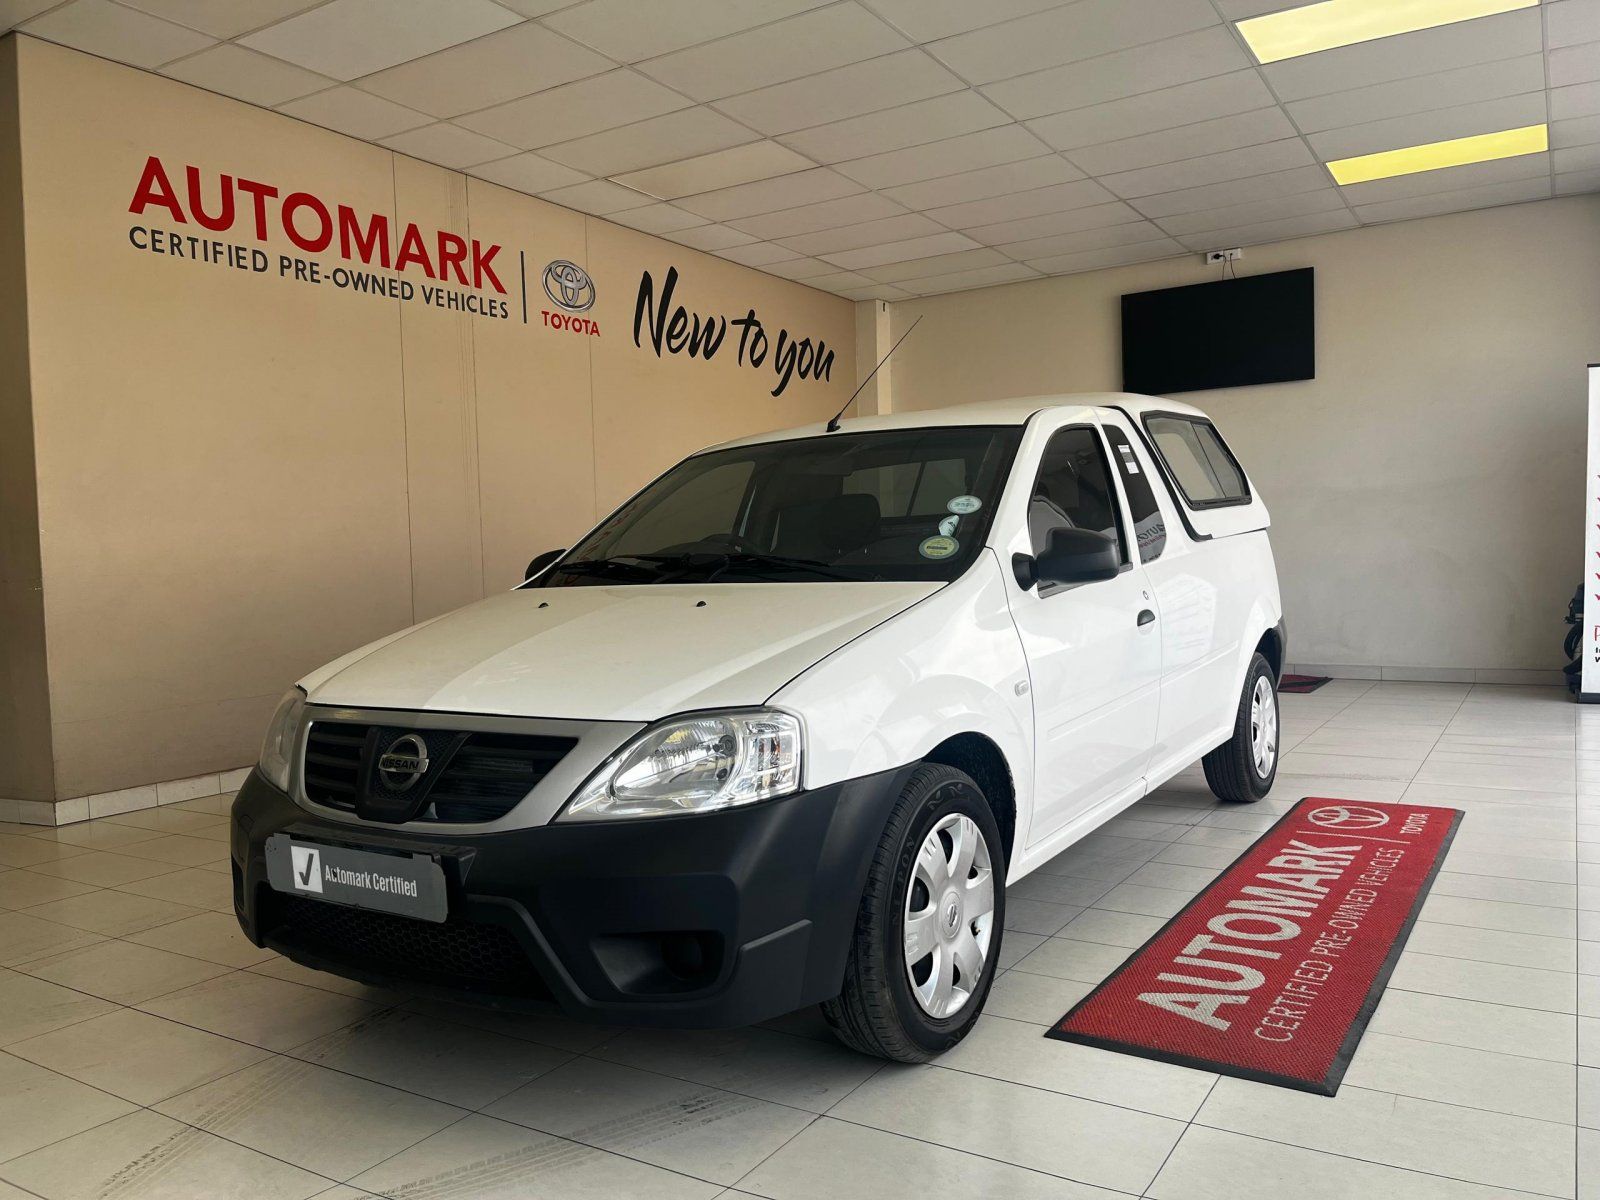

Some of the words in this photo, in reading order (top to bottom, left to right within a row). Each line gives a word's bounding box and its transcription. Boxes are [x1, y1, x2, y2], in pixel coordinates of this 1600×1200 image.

[128, 156, 507, 295] AUTOMARK
[129, 226, 269, 273] CERTIFIED
[279, 255, 414, 301] PRE-OWNED
[421, 285, 509, 319] VEHICLES
[541, 310, 601, 337] TOYOTA
[633, 265, 727, 360] New
[730, 309, 768, 369] to
[770, 328, 835, 398] you
[382, 757, 420, 771] NISSAN
[1399, 812, 1431, 835] TOYOTA
[325, 864, 371, 890] Automark
[373, 872, 418, 898] Certified
[1136, 840, 1364, 1032] AUTOMARK
[1253, 959, 1335, 1042] CERTIFIED
[1309, 887, 1378, 958] PRE-OWNED
[1354, 847, 1406, 886] VEHICLES
